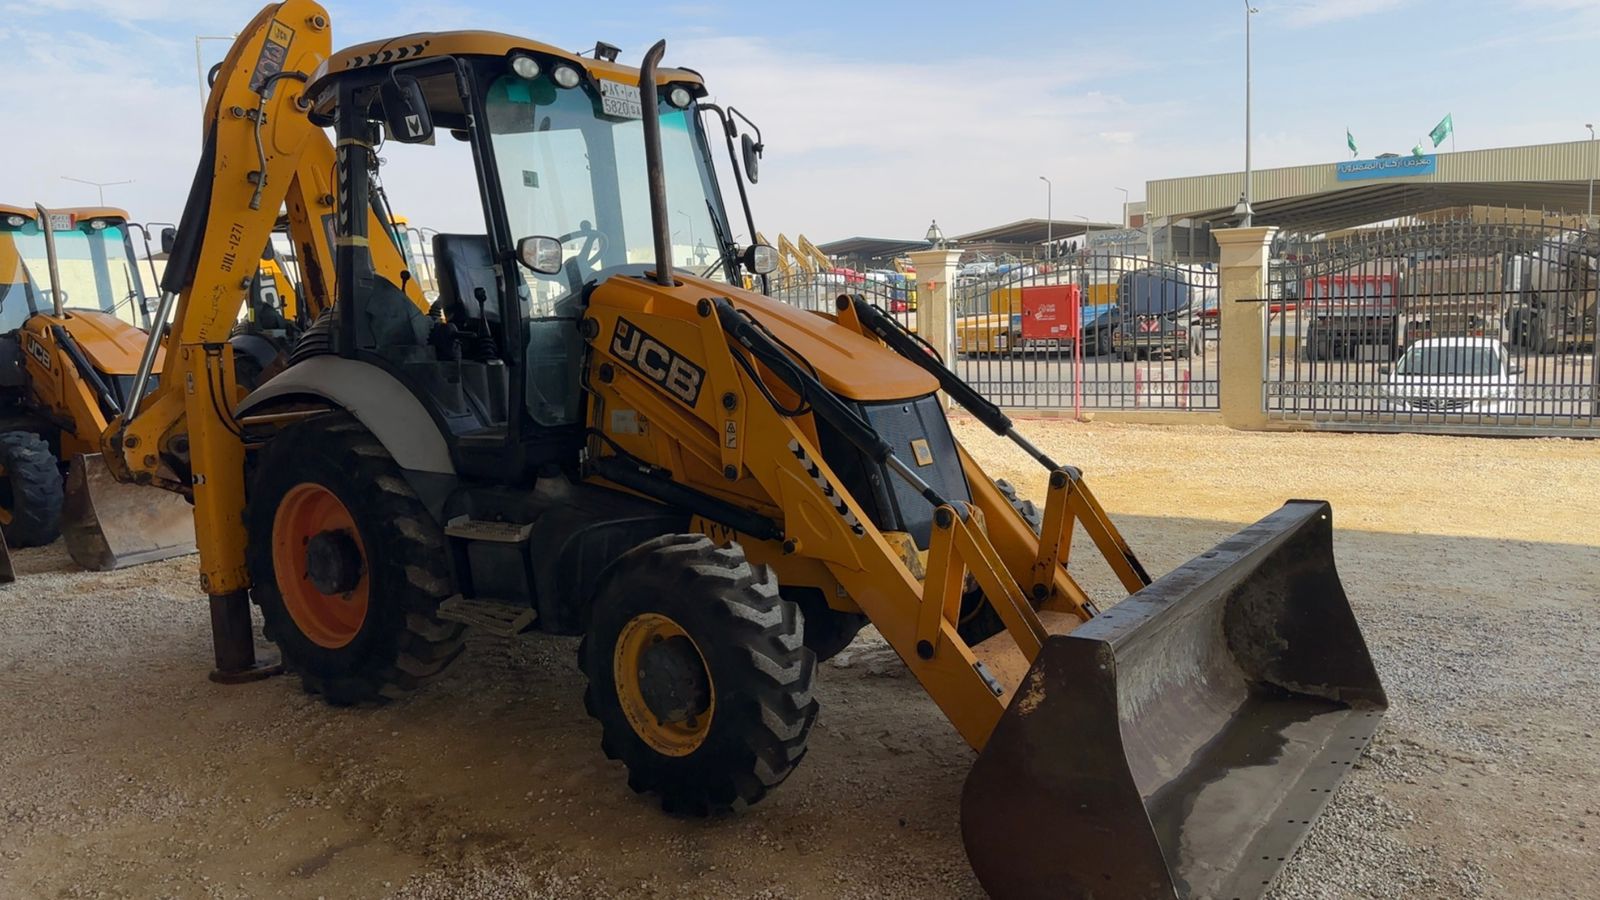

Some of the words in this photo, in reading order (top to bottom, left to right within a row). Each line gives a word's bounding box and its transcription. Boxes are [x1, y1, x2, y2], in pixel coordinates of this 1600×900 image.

[604, 98, 629, 115] 5820
[27, 336, 50, 368] JCB
[613, 323, 700, 401] JCB
